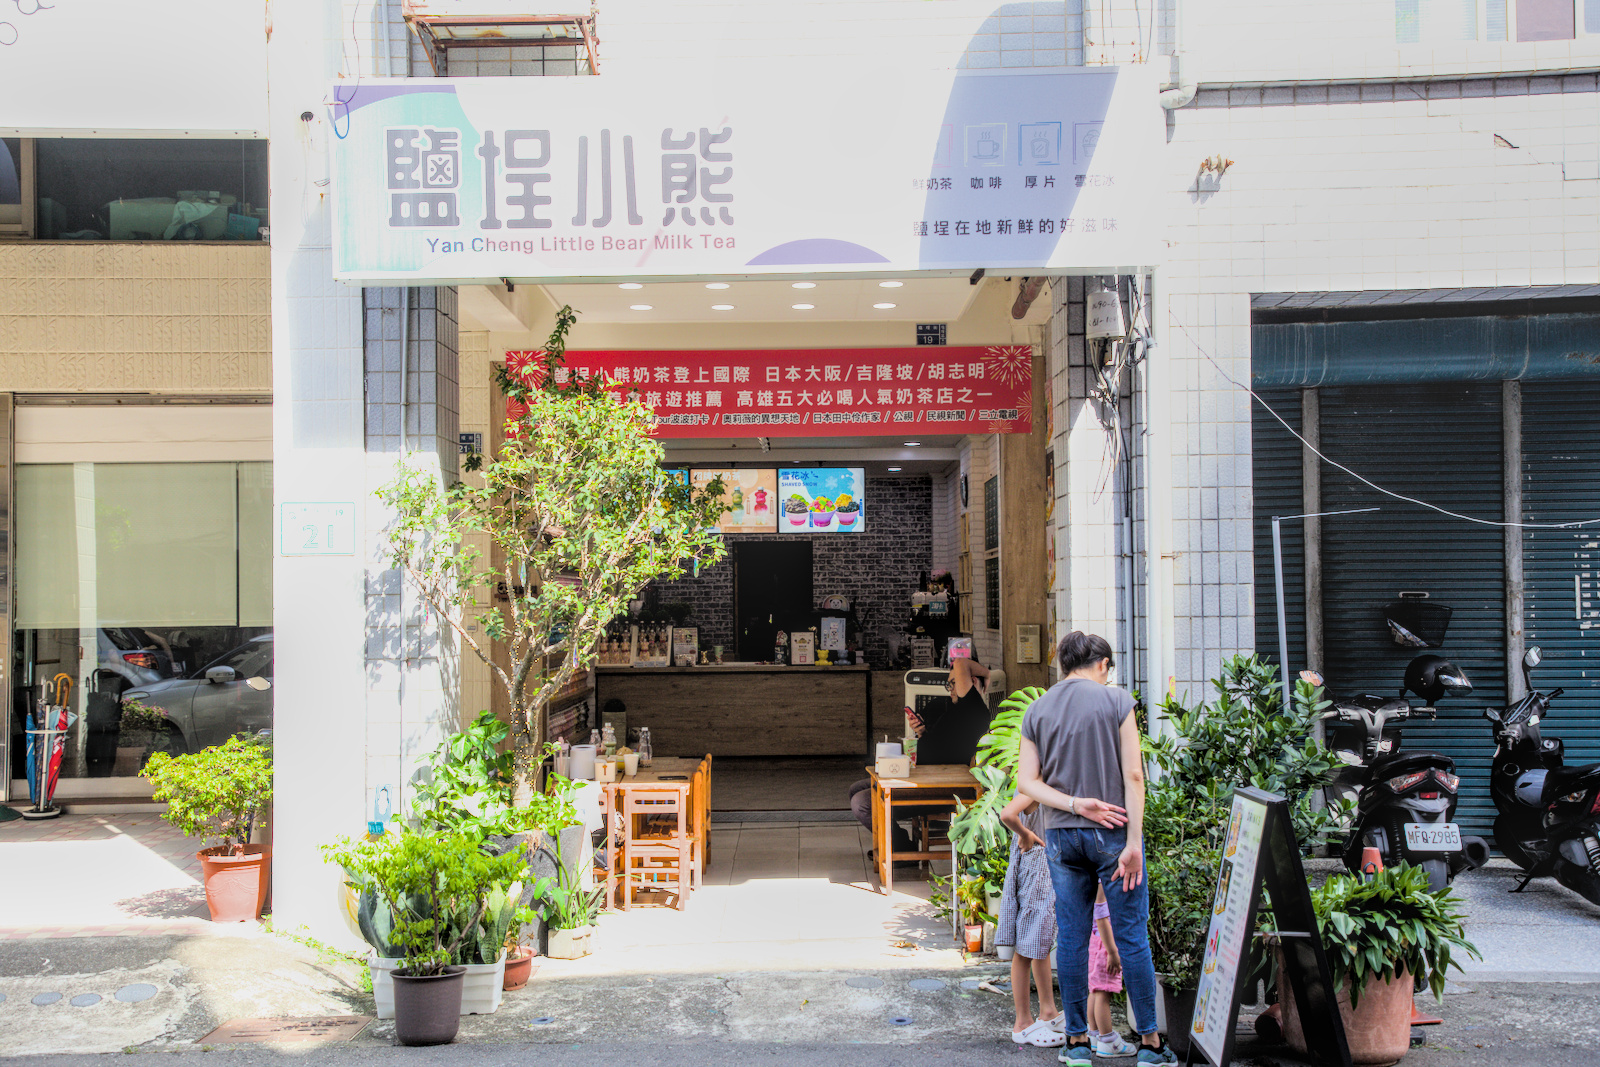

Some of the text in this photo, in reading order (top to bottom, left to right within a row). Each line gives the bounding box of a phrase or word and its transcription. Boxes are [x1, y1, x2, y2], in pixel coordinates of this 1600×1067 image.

[386, 127, 734, 230] 鹽埕小熊
[912, 174, 1115, 190] 鮮奶茶 咖啡 厚片 雪花冰
[913, 218, 1119, 236] 鹽埕在地新鮮的好滋味
[426, 234, 736, 255] Yan Cheng Little Bear Milk Tea
[923, 336, 933, 344] 19
[737, 387, 993, 407] 高雄五大必喝人氣奶茶店之一
[722, 413, 800, 425] 奧莉薇的異想天地
[893, 410, 914, 422] 公視
[926, 409, 966, 422] 民視新聞
[978, 408, 1019, 421] 三立電視
[781, 470, 810, 480] 雪花冰
